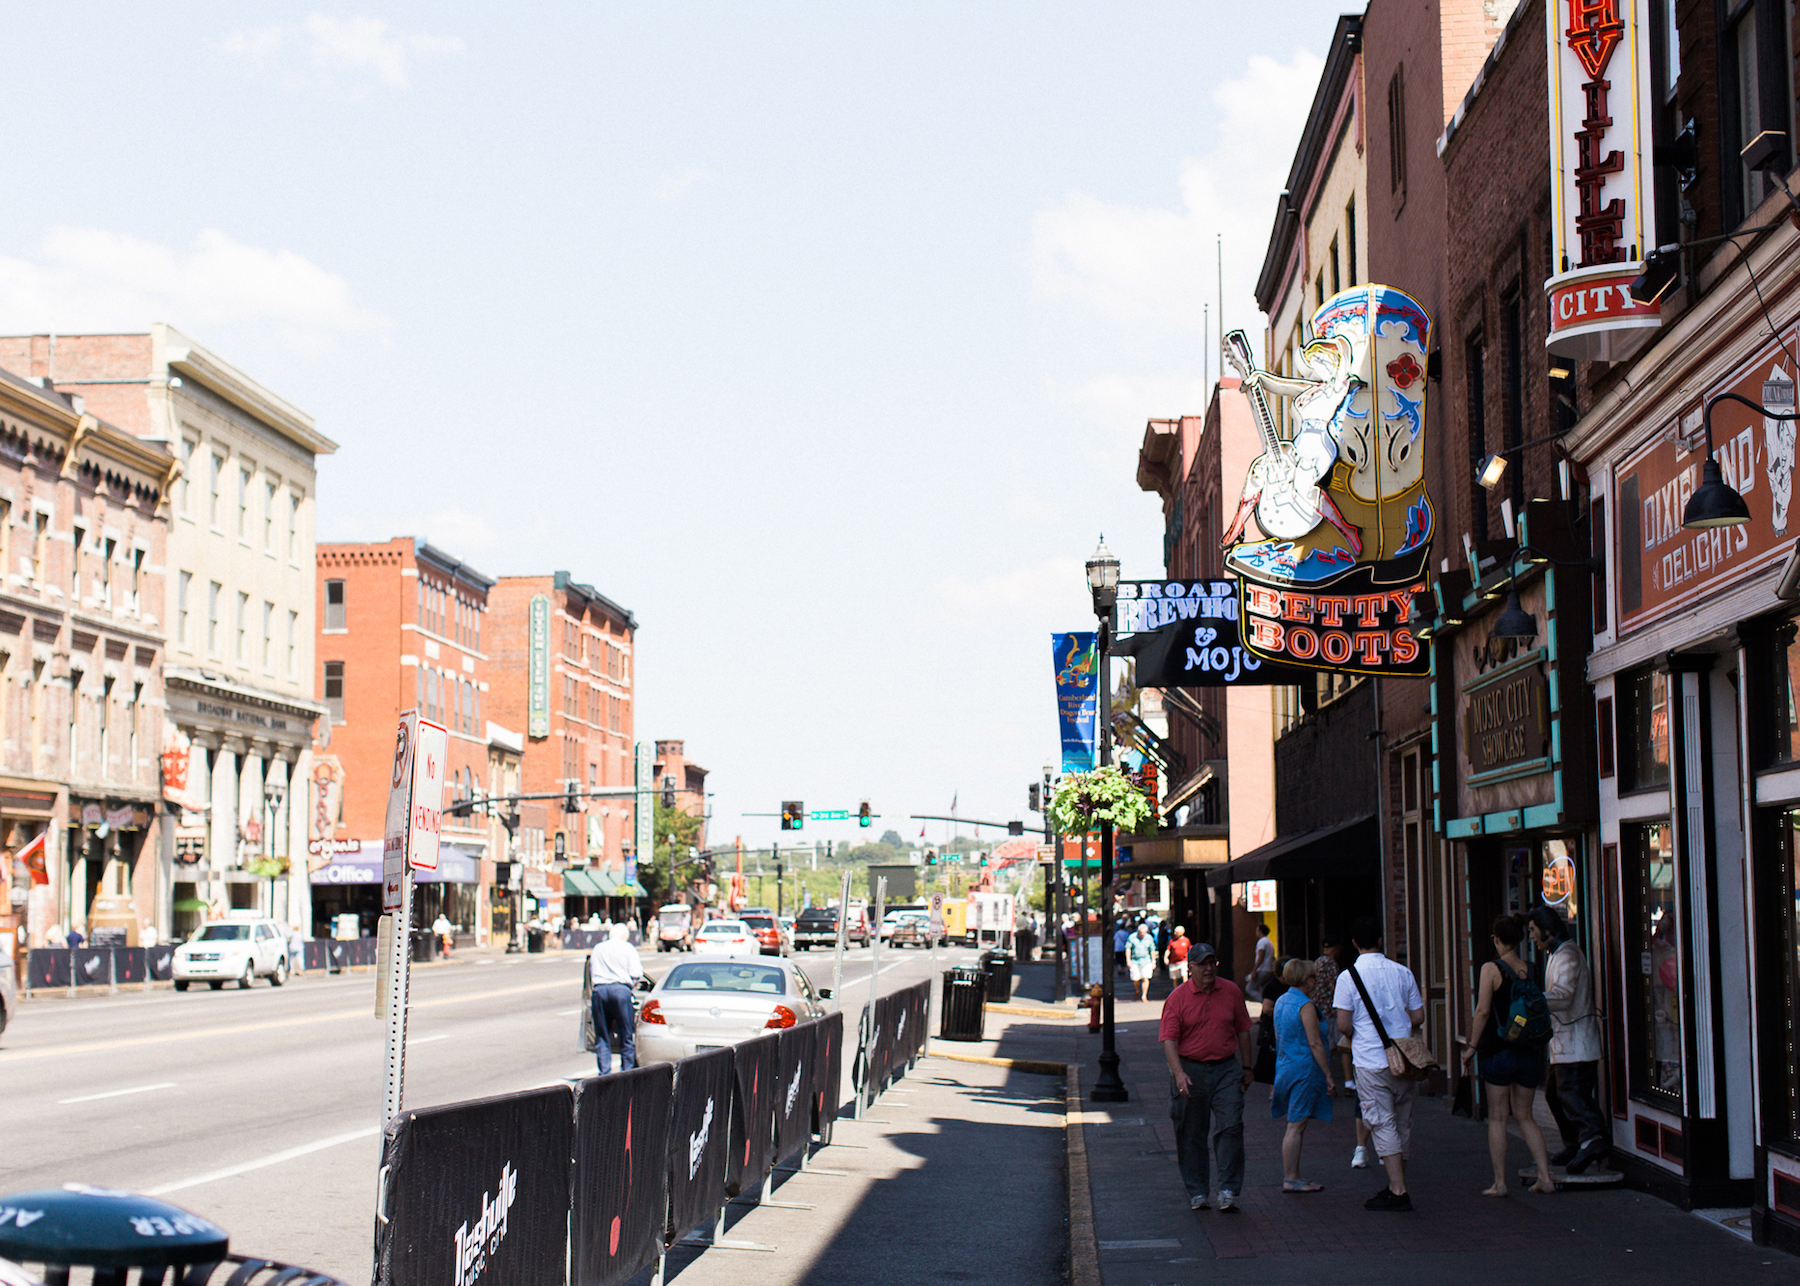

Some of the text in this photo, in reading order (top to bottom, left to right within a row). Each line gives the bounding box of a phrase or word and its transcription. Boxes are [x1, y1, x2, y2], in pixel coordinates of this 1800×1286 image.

[1559, 284, 1636, 320] CITY
[1116, 581, 1238, 599] BROAD
[1246, 581, 1425, 627] BETTY
[1194, 626, 1217, 647] &
[1250, 614, 1420, 665] BOOTS
[1473, 676, 1530, 734] MUSIC CITY
[1482, 724, 1526, 766] SHOWCASE
[415, 804, 440, 834] VENDING
[327, 864, 374, 883] Office
[1542, 865, 1574, 897] OPEN
